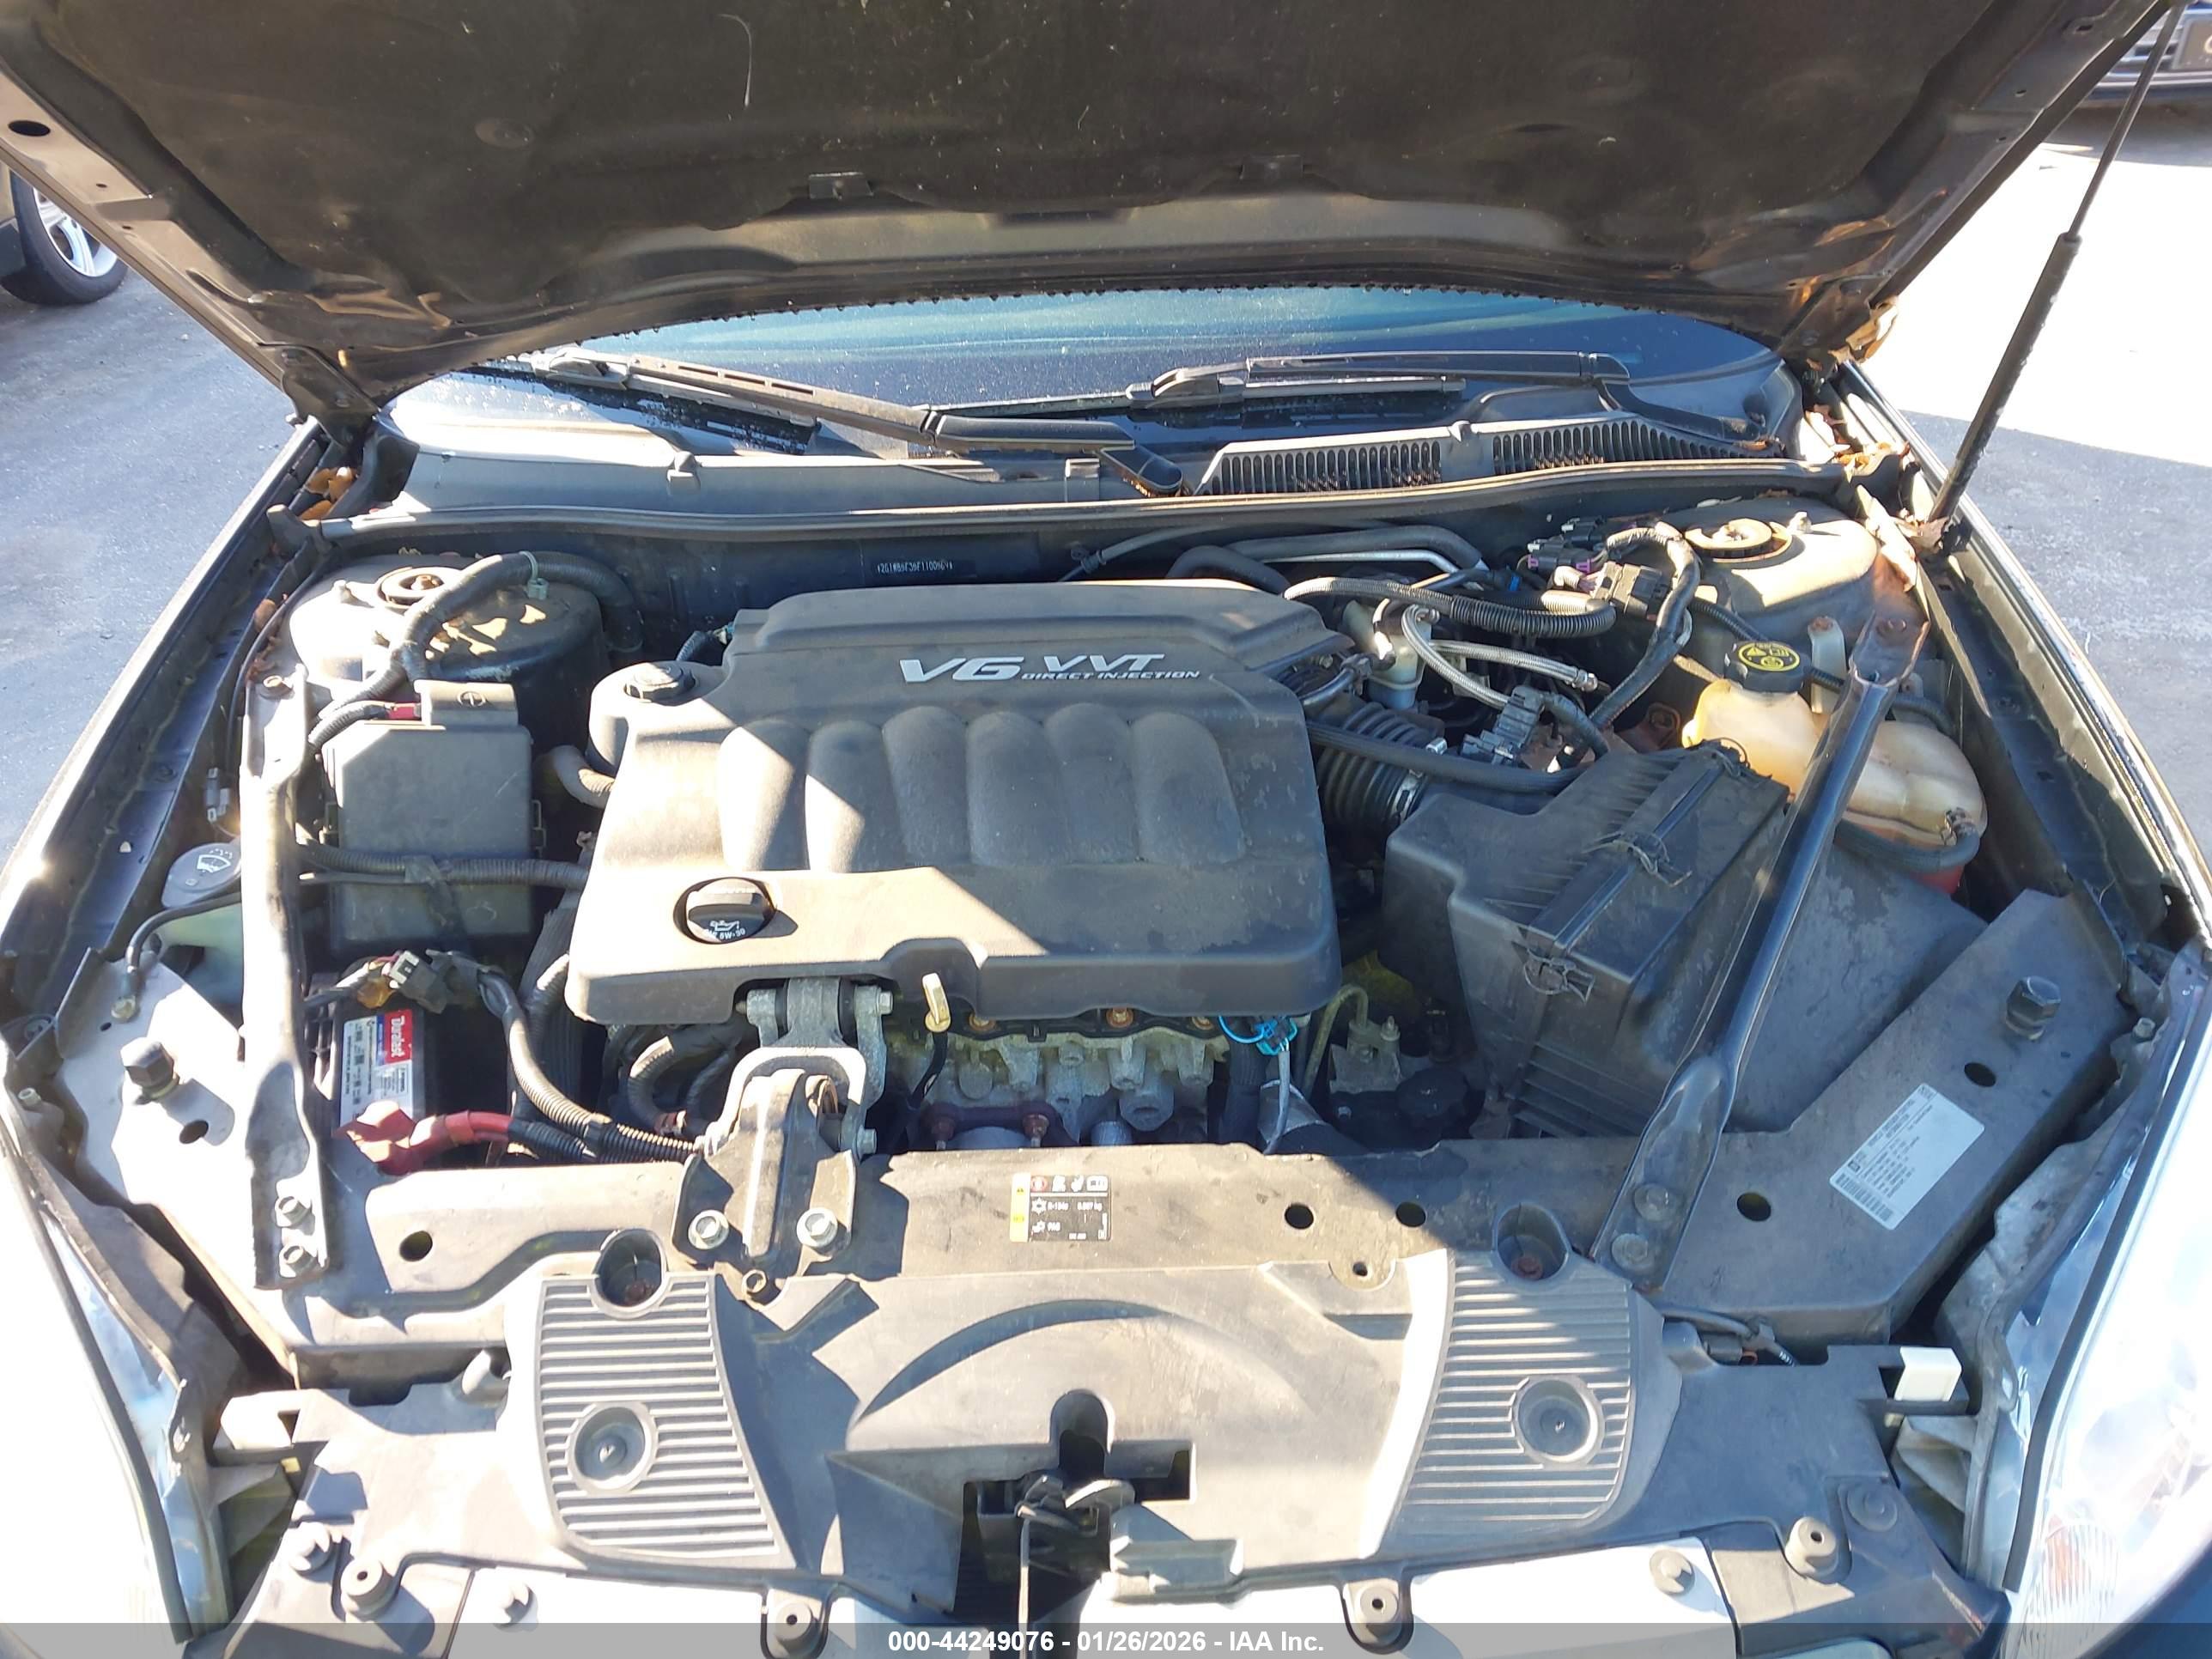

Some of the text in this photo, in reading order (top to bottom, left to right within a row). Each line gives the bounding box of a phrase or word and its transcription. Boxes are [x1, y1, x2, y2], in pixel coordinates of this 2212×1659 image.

[900, 653, 1165, 683] V6 VVT
[1021, 670, 1201, 681] DIRECT INJECTION
